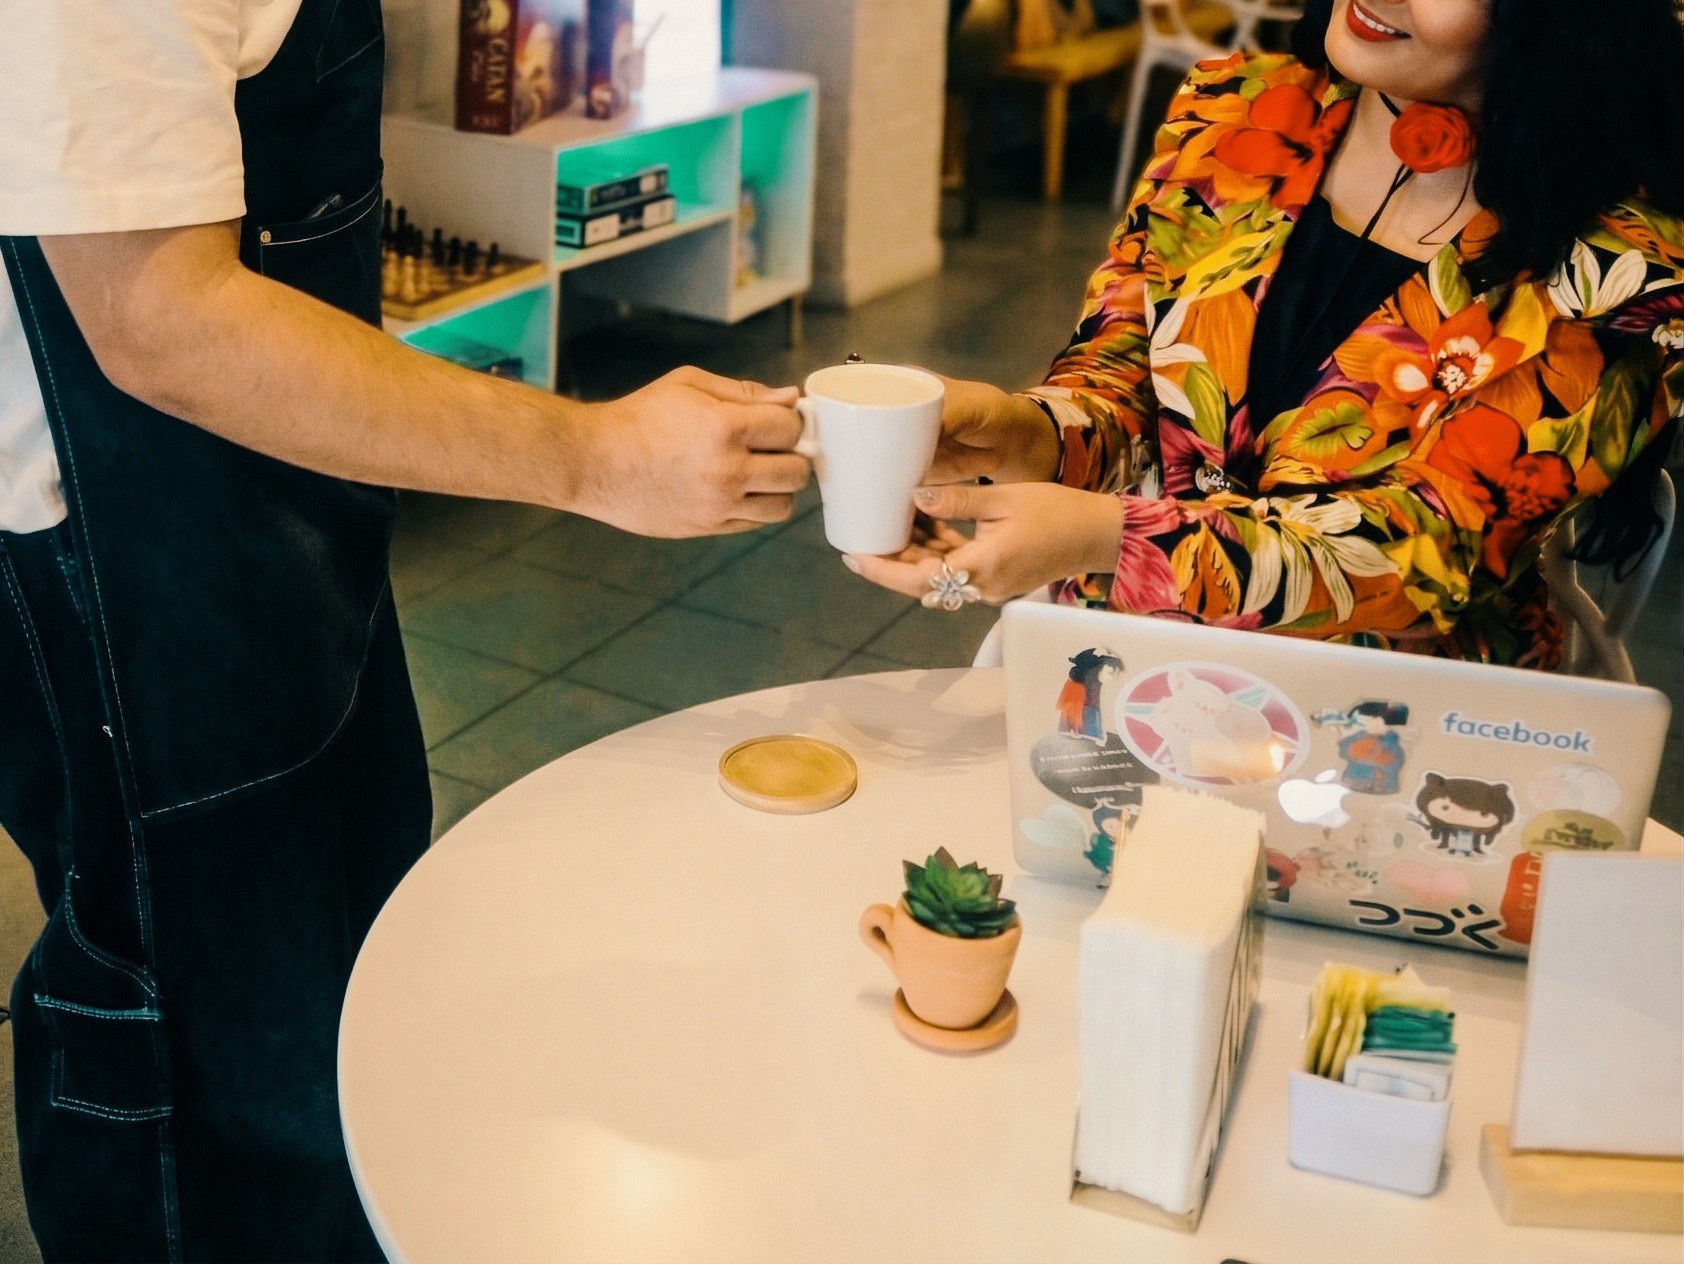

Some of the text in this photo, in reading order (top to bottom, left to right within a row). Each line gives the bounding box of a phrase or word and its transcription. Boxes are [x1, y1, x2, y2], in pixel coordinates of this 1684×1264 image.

[485, 38, 509, 102] CATAN
[1443, 712, 1591, 752] facebook
[1348, 899, 1501, 950] つづく
